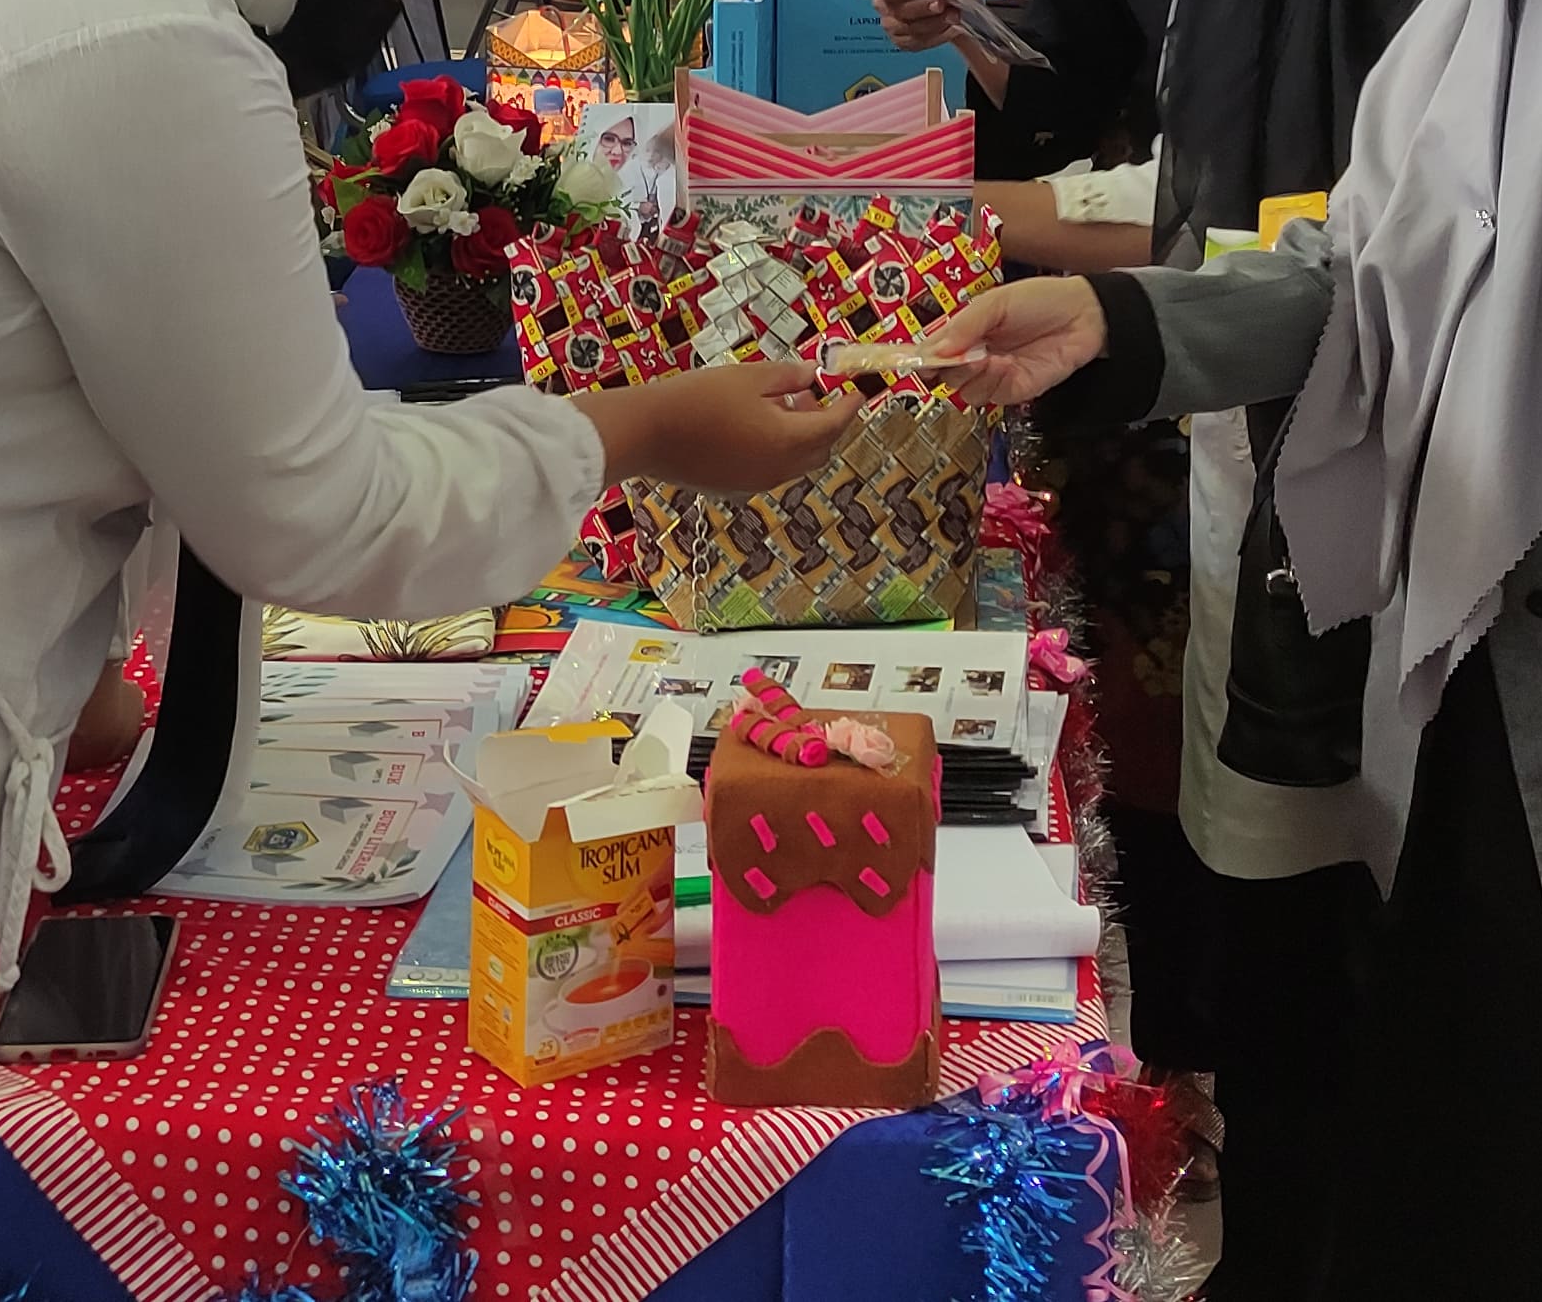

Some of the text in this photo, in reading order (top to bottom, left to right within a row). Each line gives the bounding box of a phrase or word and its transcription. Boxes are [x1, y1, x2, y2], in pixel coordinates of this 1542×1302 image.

[578, 826, 674, 870] TROPICANA
[601, 859, 642, 885] SLIM
[554, 906, 602, 929] CLASSIC
